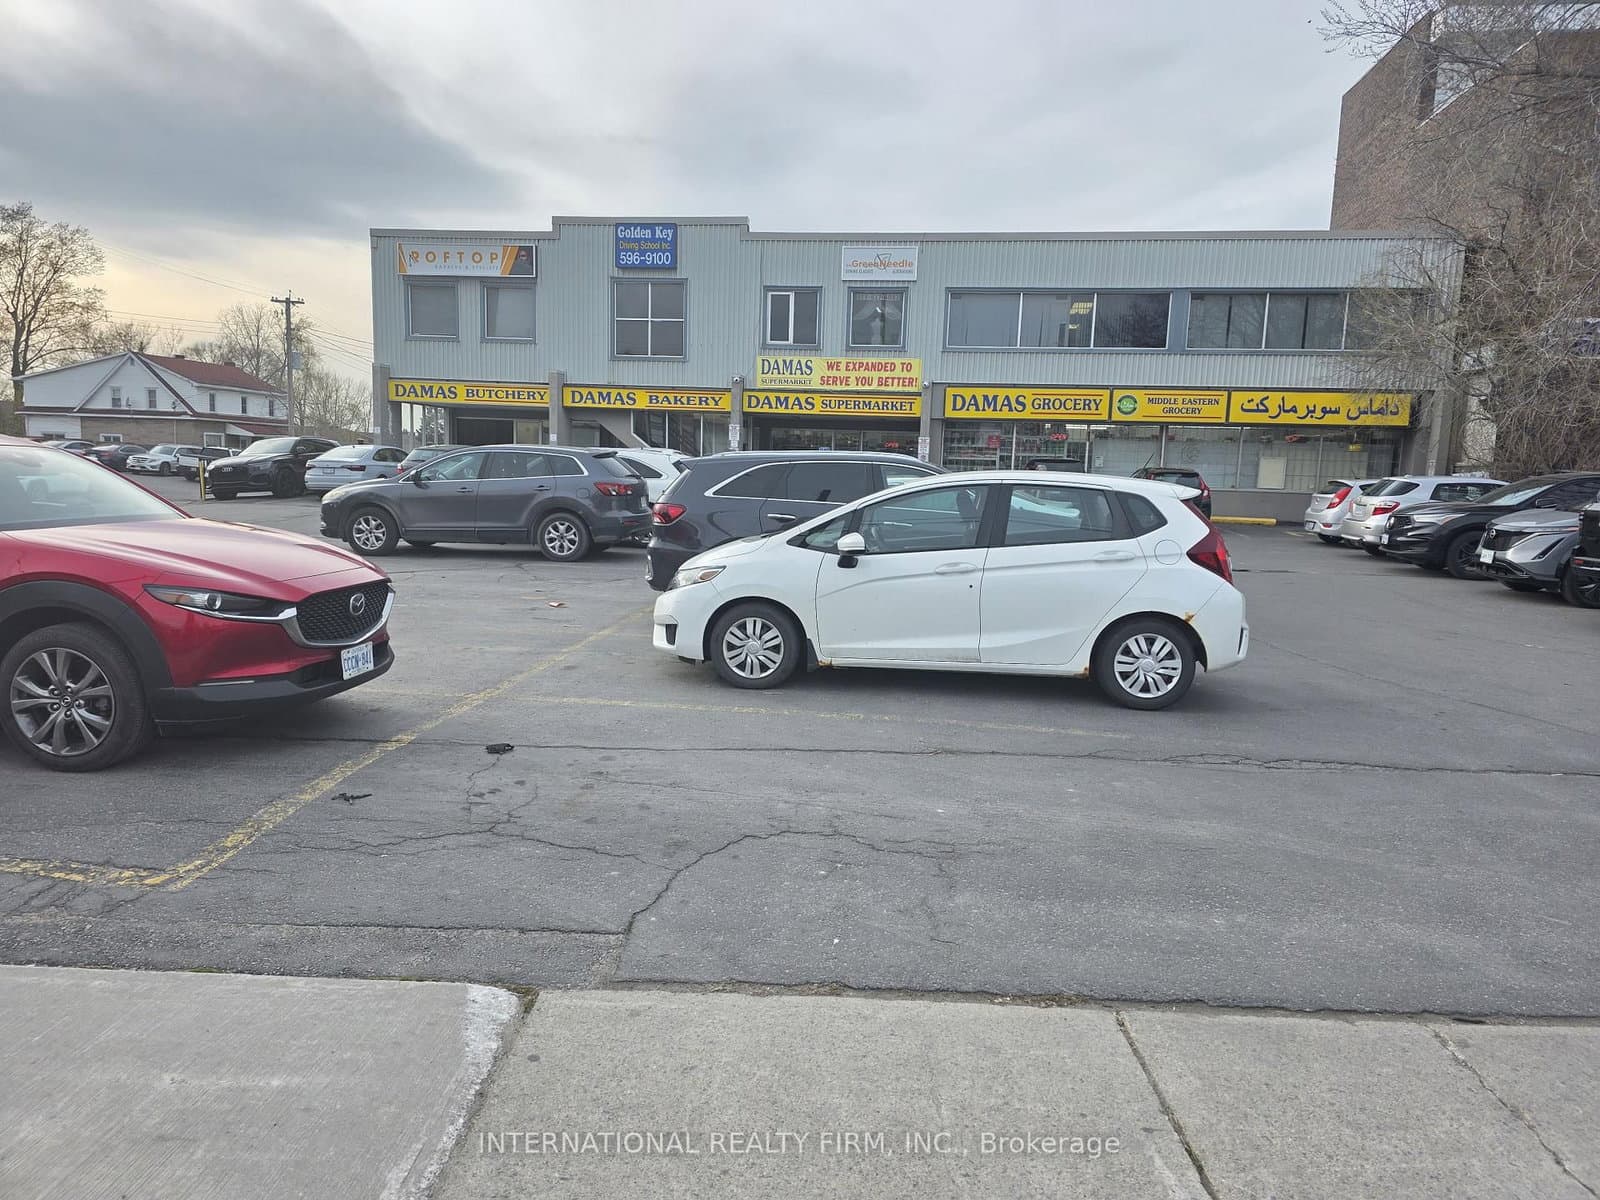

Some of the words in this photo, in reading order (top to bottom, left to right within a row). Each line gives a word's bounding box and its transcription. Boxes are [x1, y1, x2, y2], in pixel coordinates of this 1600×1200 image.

[617, 226, 652, 239] Golden
[655, 226, 674, 241] Key
[640, 240, 660, 250] School
[619, 251, 672, 265] 596-9100
[760, 358, 813, 376] DAMAS
[826, 361, 842, 372] WE
[845, 361, 896, 373] EXPANDED
[900, 362, 913, 373] TO
[761, 378, 813, 386] SUPERMARKET
[819, 375, 851, 386] SERVE
[855, 375, 874, 387] YOU
[877, 376, 918, 388] BETTER!
[394, 383, 458, 400] DAMAS
[465, 388, 548, 401] BUTCHERY
[570, 390, 637, 406] DAMAS
[648, 394, 723, 407] BAKERY
[746, 394, 816, 411] DAMAS
[820, 399, 915, 412] SUPERMARKET
[951, 393, 1027, 413] DAMAS
[1031, 397, 1103, 412] GROCERY
[1147, 396, 1179, 405] MIDDLE
[1181, 397, 1220, 406] EASTERN
[1162, 406, 1203, 415] GROCERY
